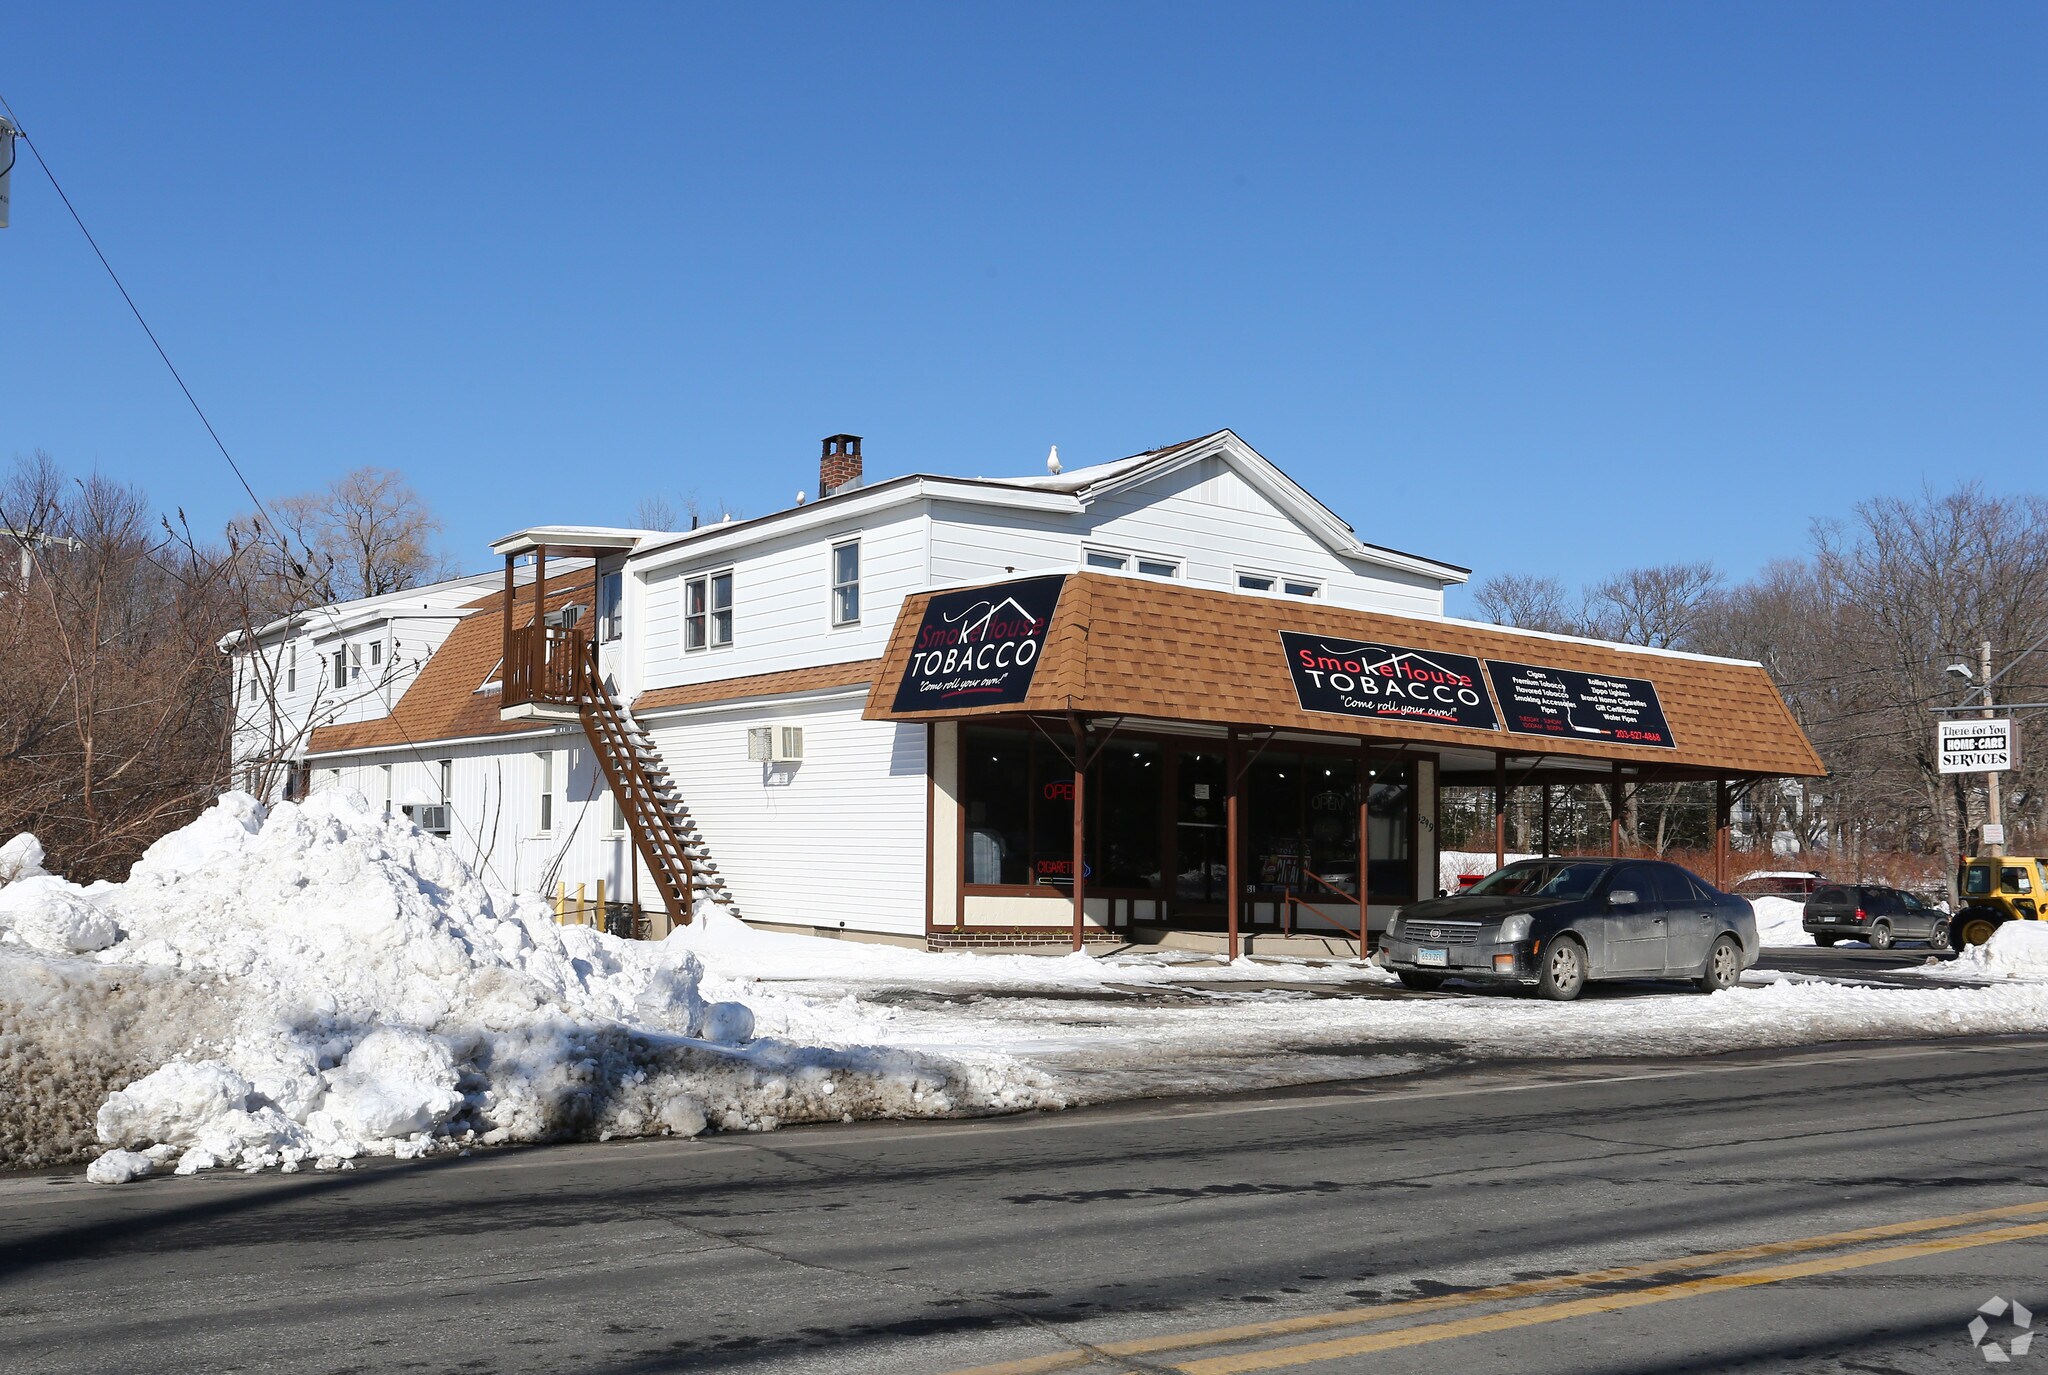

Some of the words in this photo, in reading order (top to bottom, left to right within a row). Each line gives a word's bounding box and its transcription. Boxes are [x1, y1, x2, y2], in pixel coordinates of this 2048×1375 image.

[912, 639, 1037, 677] TOBACCO
[1526, 670, 1546, 679] Cigars
[919, 680, 943, 693] "Come
[943, 677, 960, 691] roll
[958, 677, 980, 692] your
[980, 672, 1008, 688] own!"
[1305, 669, 1480, 706] TOBACCO
[1512, 677, 1539, 686] Premium
[1539, 681, 1566, 689] Tobacco
[1588, 679, 1608, 687] Rolling
[1608, 681, 1627, 689] Papers
[1516, 686, 1542, 694] Flavored
[1542, 690, 1569, 698] Tobacco
[1591, 687, 1608, 695] Zippo
[1609, 689, 1630, 697] Lighters
[1515, 695, 1541, 704] Smoking
[1581, 694, 1598, 702] Brand
[1599, 696, 1617, 704] Name
[1618, 699, 1647, 707] Cigarettes
[1340, 695, 1376, 711] "Come
[1377, 701, 1399, 712] roll
[1400, 704, 1425, 715] your
[1427, 707, 1458, 718] own!"
[1541, 706, 1557, 714] Pipes
[1607, 706, 1639, 715] Certificates
[1615, 730, 1661, 741] 203-527-4868
[1942, 727, 1969, 736] There
[1972, 725, 1986, 735] for
[1988, 725, 2006, 734] You
[1943, 753, 2007, 766] SERVICES
[1043, 783, 1075, 801] OPE
